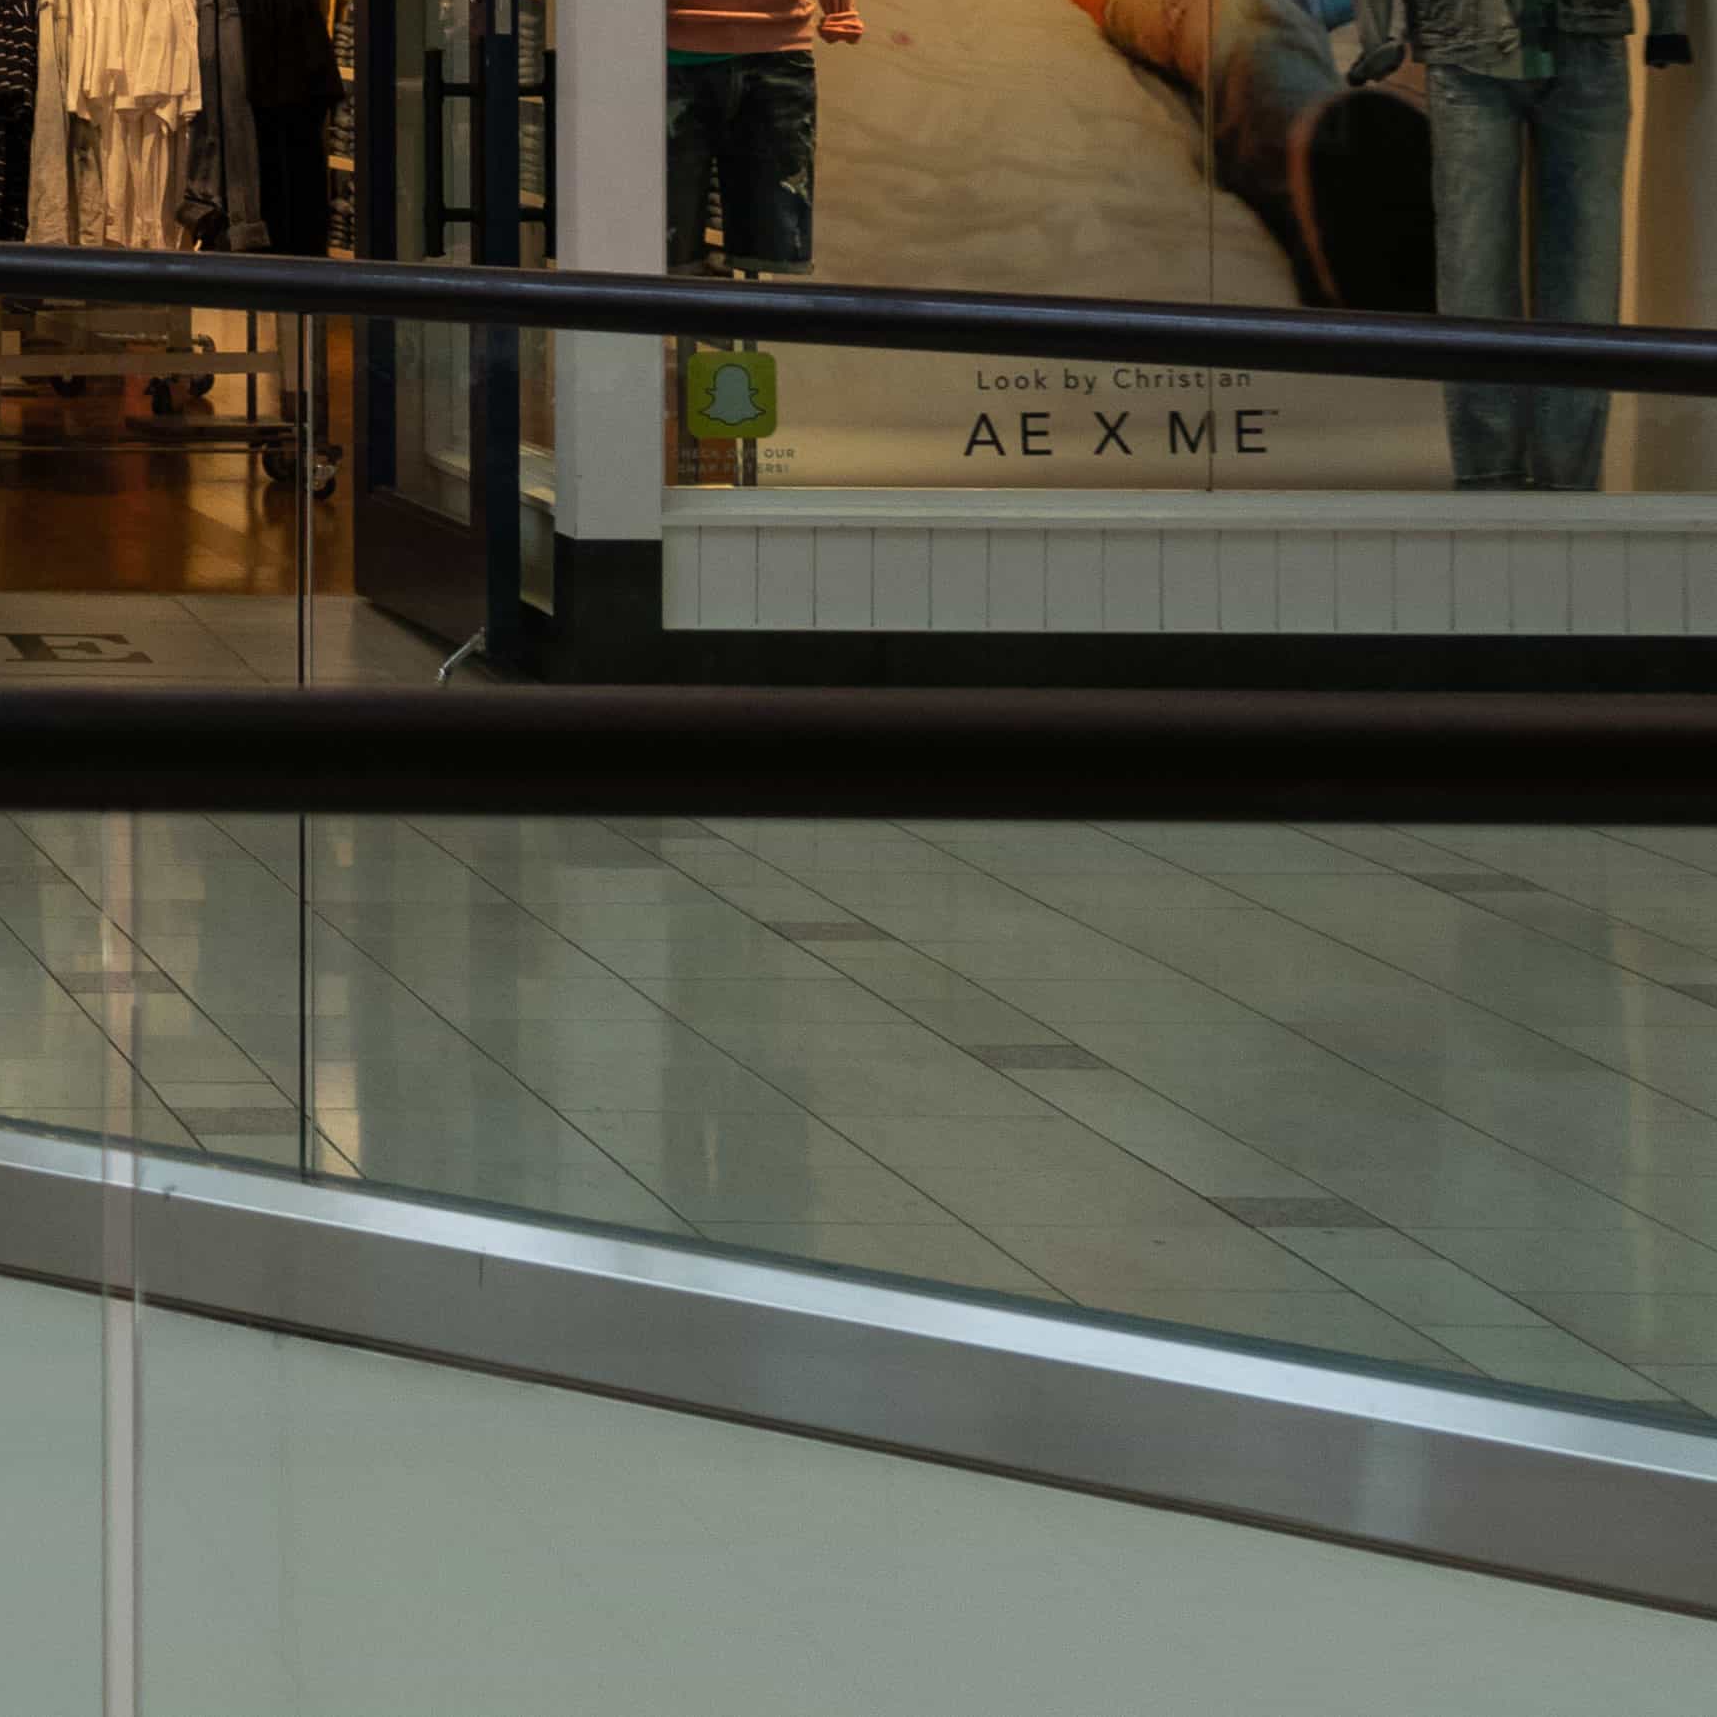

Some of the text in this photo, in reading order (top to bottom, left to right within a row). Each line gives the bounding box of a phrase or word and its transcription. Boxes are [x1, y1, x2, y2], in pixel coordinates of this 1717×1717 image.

[977, 368, 1252, 395] Look by Christan
[964, 411, 1052, 456] AE
[1094, 410, 1133, 456] X
[763, 448, 795, 459] OUR
